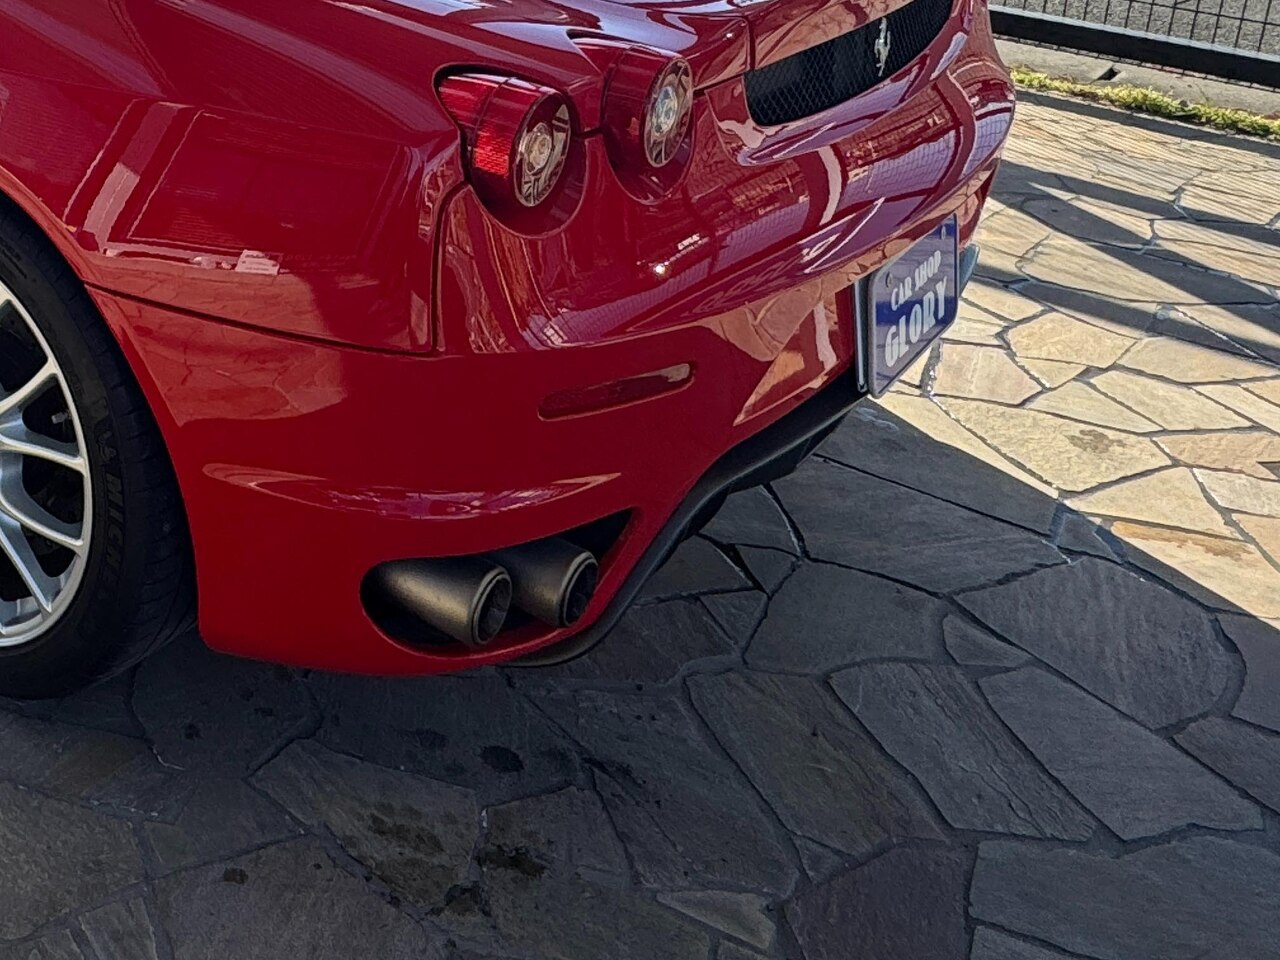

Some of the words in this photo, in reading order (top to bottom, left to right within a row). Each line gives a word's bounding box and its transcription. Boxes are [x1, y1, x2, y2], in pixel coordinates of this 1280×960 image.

[891, 276, 913, 311] CAR
[915, 250, 941, 291] SHOP
[885, 276, 947, 367] GLORY
